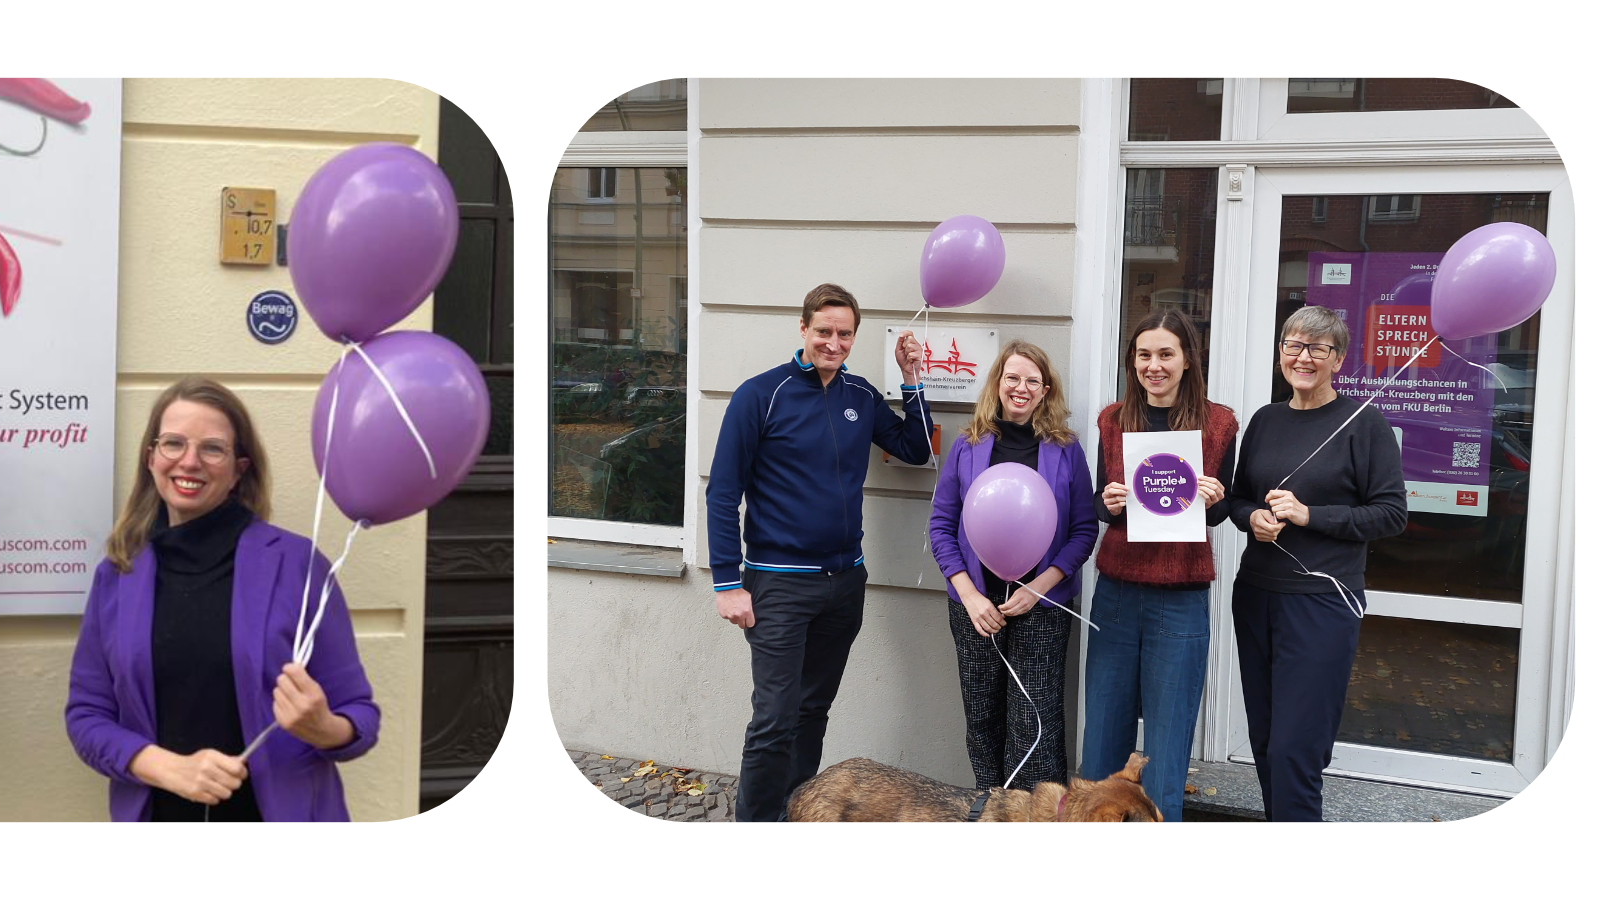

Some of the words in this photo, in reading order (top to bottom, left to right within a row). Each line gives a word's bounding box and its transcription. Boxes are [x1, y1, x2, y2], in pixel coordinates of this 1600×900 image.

[252, 302, 294, 317] Bewag
[1378, 314, 1427, 326] ELTERN
[1377, 330, 1428, 342] SPRECH
[1376, 346, 1428, 358] STUNDE
[1338, 375, 1359, 384] über
[1360, 376, 1456, 388] Ausbildungschancen
[1458, 380, 1468, 388] in
[9, 389, 89, 416] System
[1438, 392, 1454, 400] mit
[1456, 392, 1474, 401] den
[1402, 402, 1421, 412] FKU
[1423, 403, 1452, 413] Berlin
[22, 422, 88, 448] profit
[1142, 476, 1178, 487] Purple
